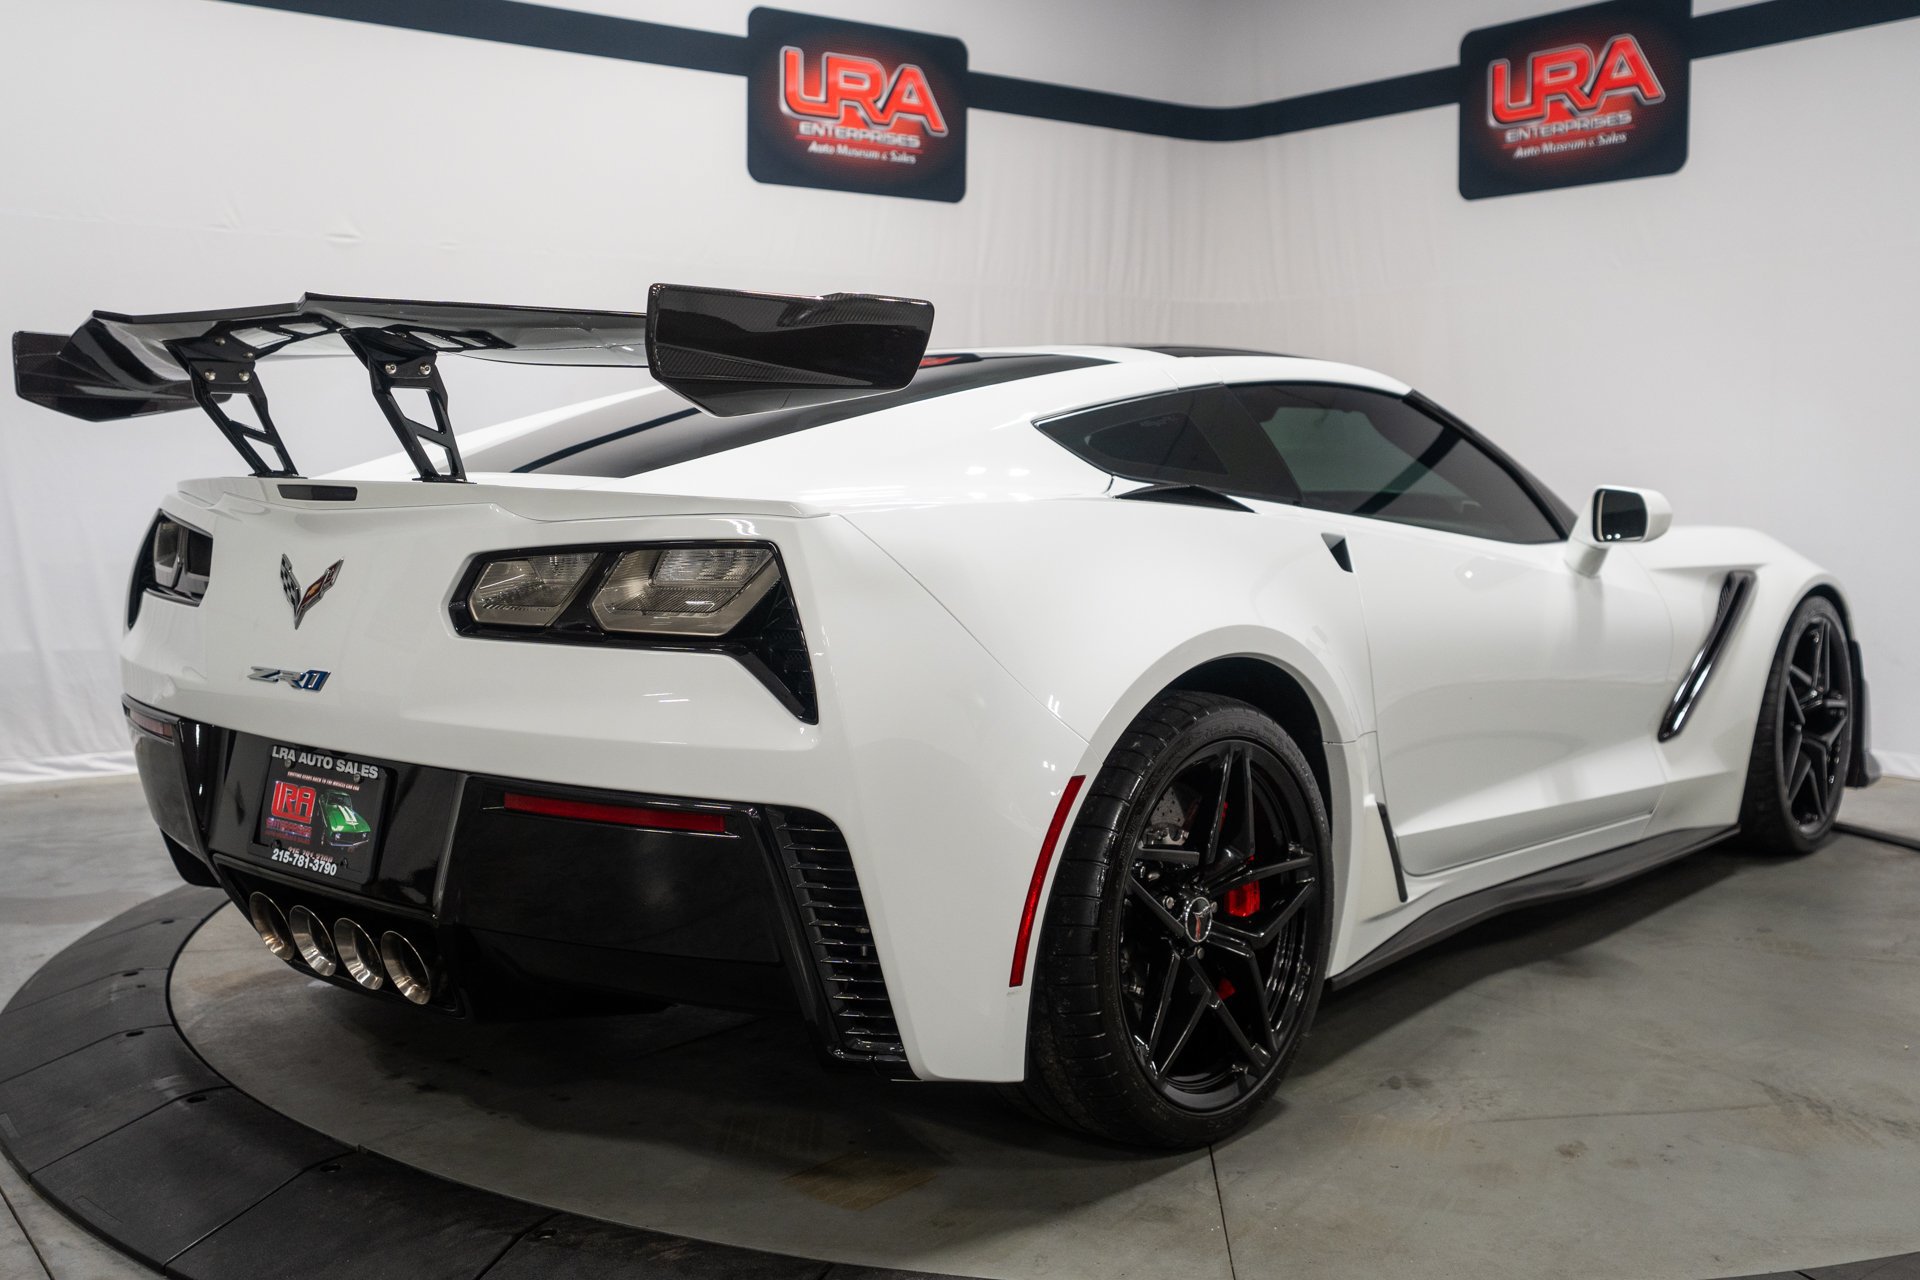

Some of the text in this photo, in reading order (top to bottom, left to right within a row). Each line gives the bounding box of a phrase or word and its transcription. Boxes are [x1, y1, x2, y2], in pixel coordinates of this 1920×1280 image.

[780, 45, 949, 137] LRA
[1487, 33, 1666, 129] LRA
[798, 121, 921, 149] ENTERPRISES
[1505, 110, 1632, 143] ENTERPRISES
[807, 140, 836, 155] Auto
[836, 143, 881, 160] Museum
[889, 149, 917, 165] Sales
[1512, 145, 1541, 160] Auto
[1541, 138, 1587, 155] Museum
[1597, 131, 1628, 147] Sales
[271, 745, 296, 762] LRA
[298, 752, 334, 770] AUTO
[335, 759, 379, 780] SALES
[271, 848, 337, 876] 215-781-3790
